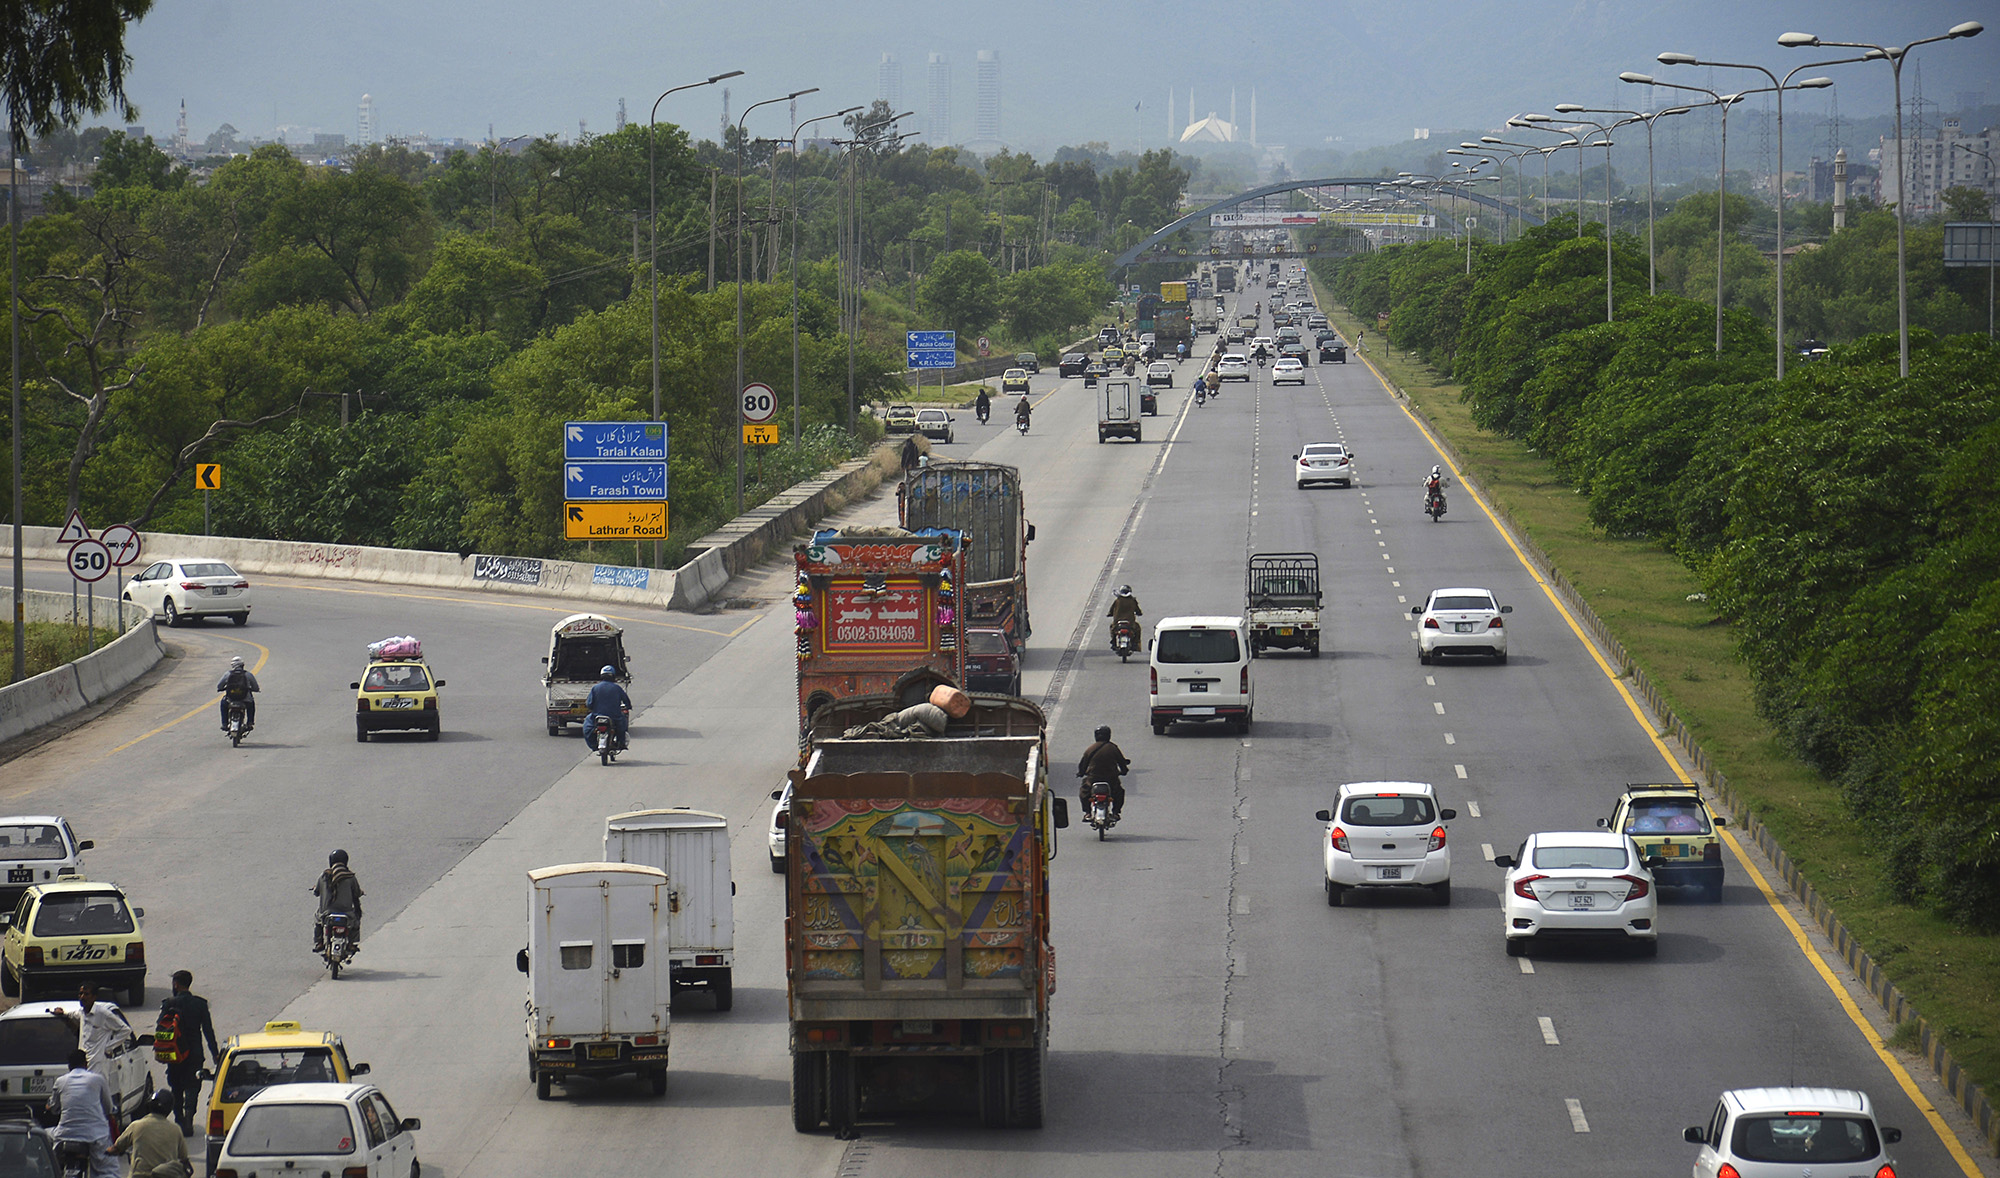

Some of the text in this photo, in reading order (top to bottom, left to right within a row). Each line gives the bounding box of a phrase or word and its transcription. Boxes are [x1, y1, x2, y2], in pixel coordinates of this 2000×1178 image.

[744, 395, 770, 411] 80
[747, 434, 770, 443] LTV
[596, 446, 663, 456] Tarlai Kalan
[590, 485, 663, 495] Farash Town
[589, 525, 663, 535] Lathrar Road
[74, 552, 105, 570] 50
[835, 607, 872, 624] میر
[837, 625, 915, 640] 0302-5184059
[66, 949, 105, 960] 1410
